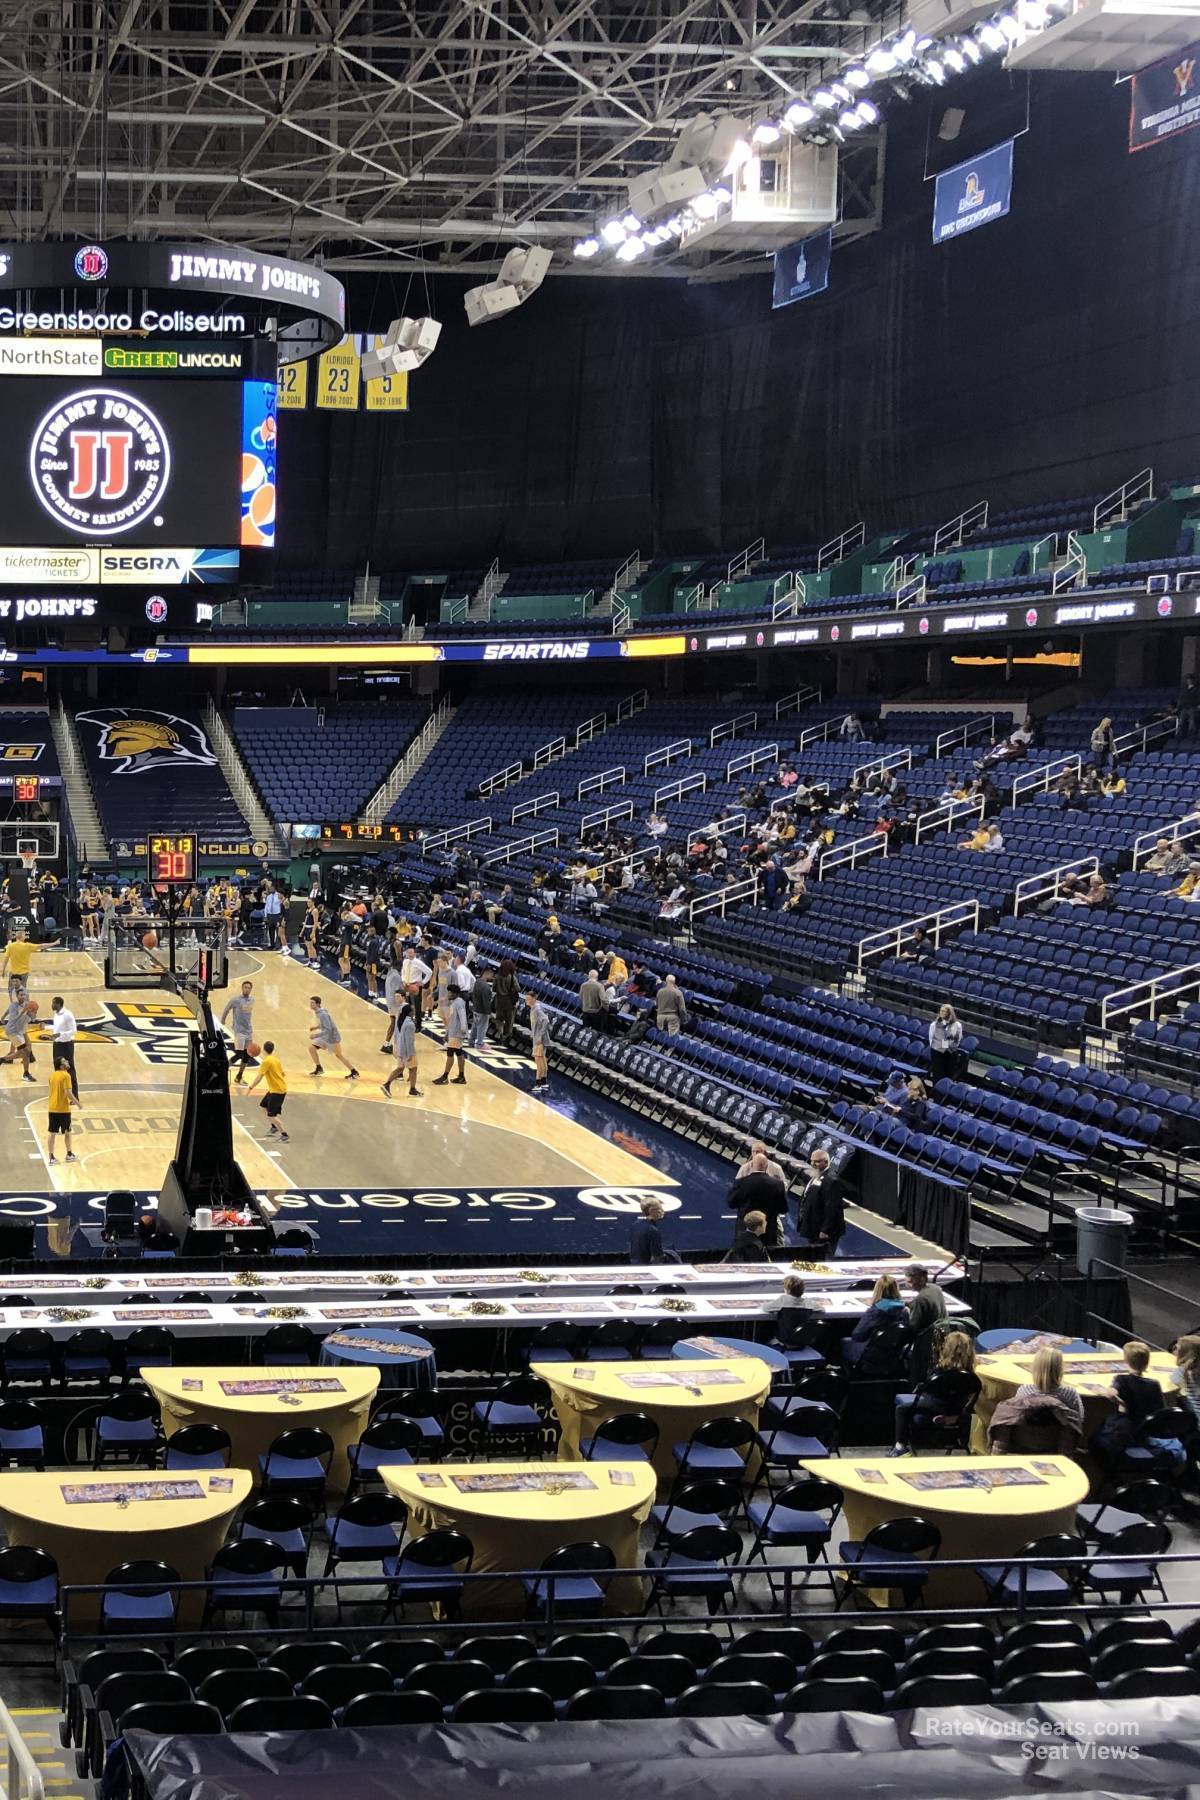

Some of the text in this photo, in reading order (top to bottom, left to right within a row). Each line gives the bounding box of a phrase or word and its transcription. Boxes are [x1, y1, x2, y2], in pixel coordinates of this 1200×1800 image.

[170, 254, 321, 299] JIMMY JOHN'S
[140, 309, 245, 332] Coliseum
[1, 349, 99, 366] NorthState
[104, 347, 241, 368] GREEN LINCOLN
[326, 354, 354, 365] ELDRIDGE
[278, 368, 297, 392] 42
[328, 368, 349, 392] 23
[383, 375, 392, 393] 5
[40, 399, 161, 457] JIMMY JOHN'S
[40, 458, 68, 471] Since
[69, 431, 133, 500] JJ
[134, 459, 160, 472] 1983
[42, 473, 159, 525] GOURMET SANDWICHES
[4, 555, 82, 568] ticketmaster
[104, 557, 180, 571] SEGRA
[45, 568, 79, 577] TICKETS
[16, 599, 96, 621] JOHN'S
[483, 642, 589, 660] SPARTANS
[18, 785, 35, 800] 30
[153, 839, 191, 853] 27:13
[208, 844, 250, 855] CLUB
[159, 854, 186, 878] 30
